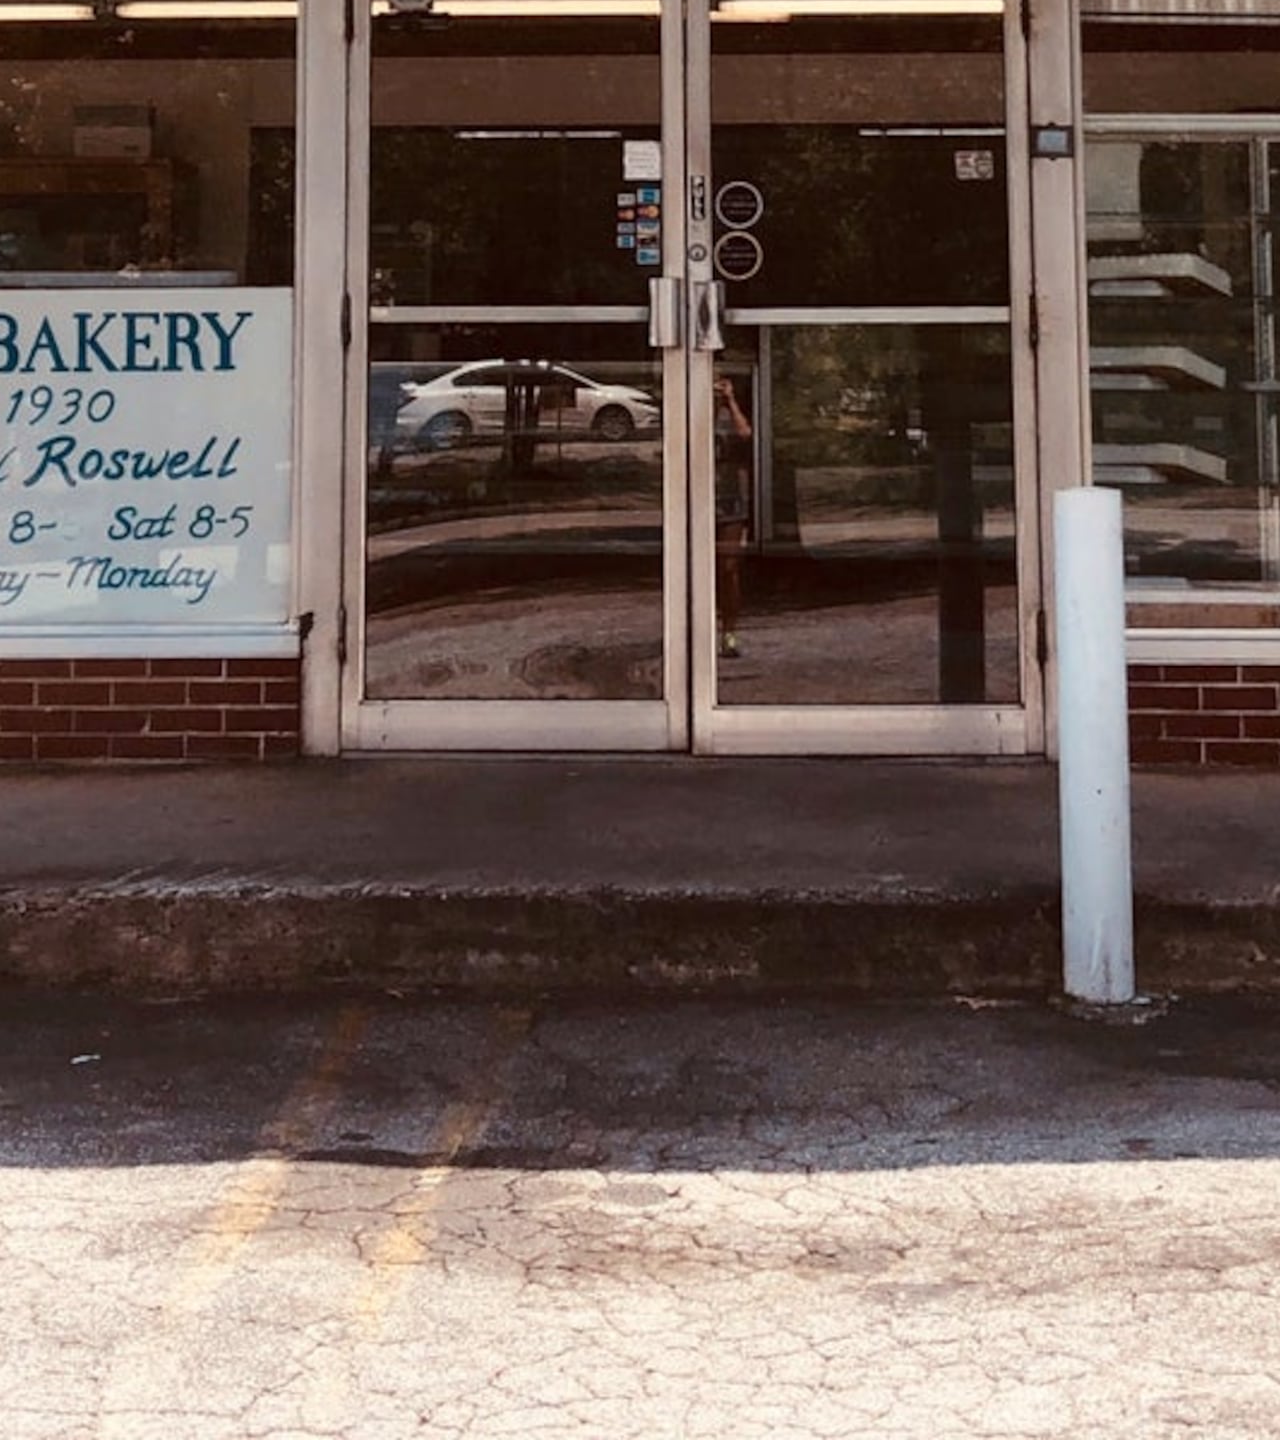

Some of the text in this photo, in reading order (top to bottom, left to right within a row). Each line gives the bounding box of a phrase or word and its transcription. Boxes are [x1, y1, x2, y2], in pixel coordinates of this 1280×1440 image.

[7, 385, 116, 426] 1930
[23, 435, 242, 488] Roswell
[108, 504, 177, 541] Sat
[189, 505, 254, 539] 8-5
